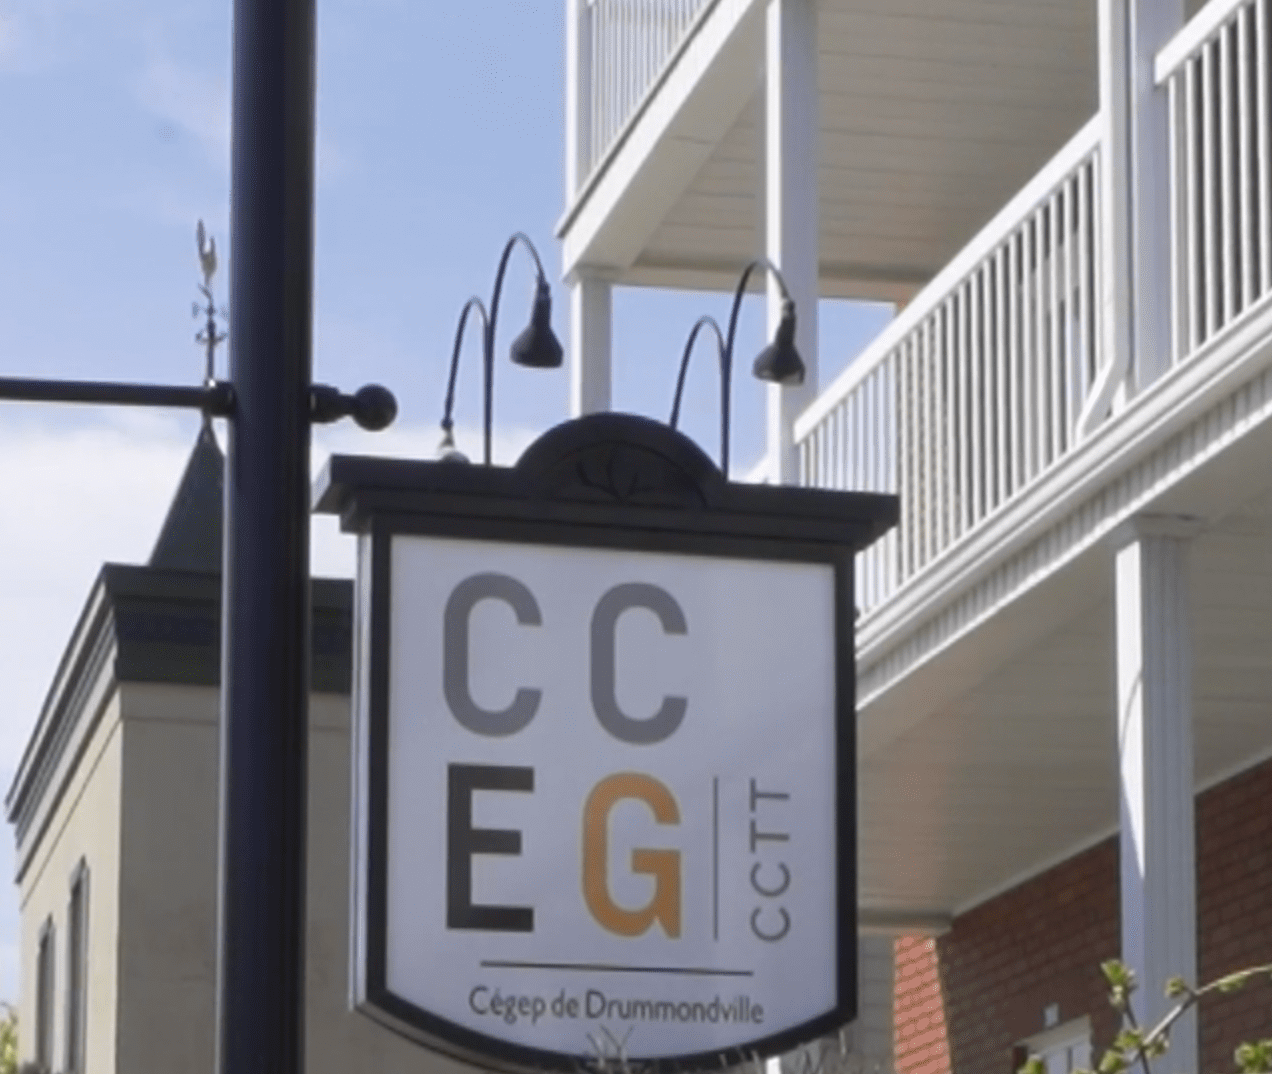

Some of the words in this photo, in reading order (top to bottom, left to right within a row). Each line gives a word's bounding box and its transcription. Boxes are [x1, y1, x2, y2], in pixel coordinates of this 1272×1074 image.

[750, 777, 792, 943] CCTT
[468, 985, 546, 1025] Cégep
[550, 988, 579, 1018] de
[585, 989, 765, 1024] Drummondville
